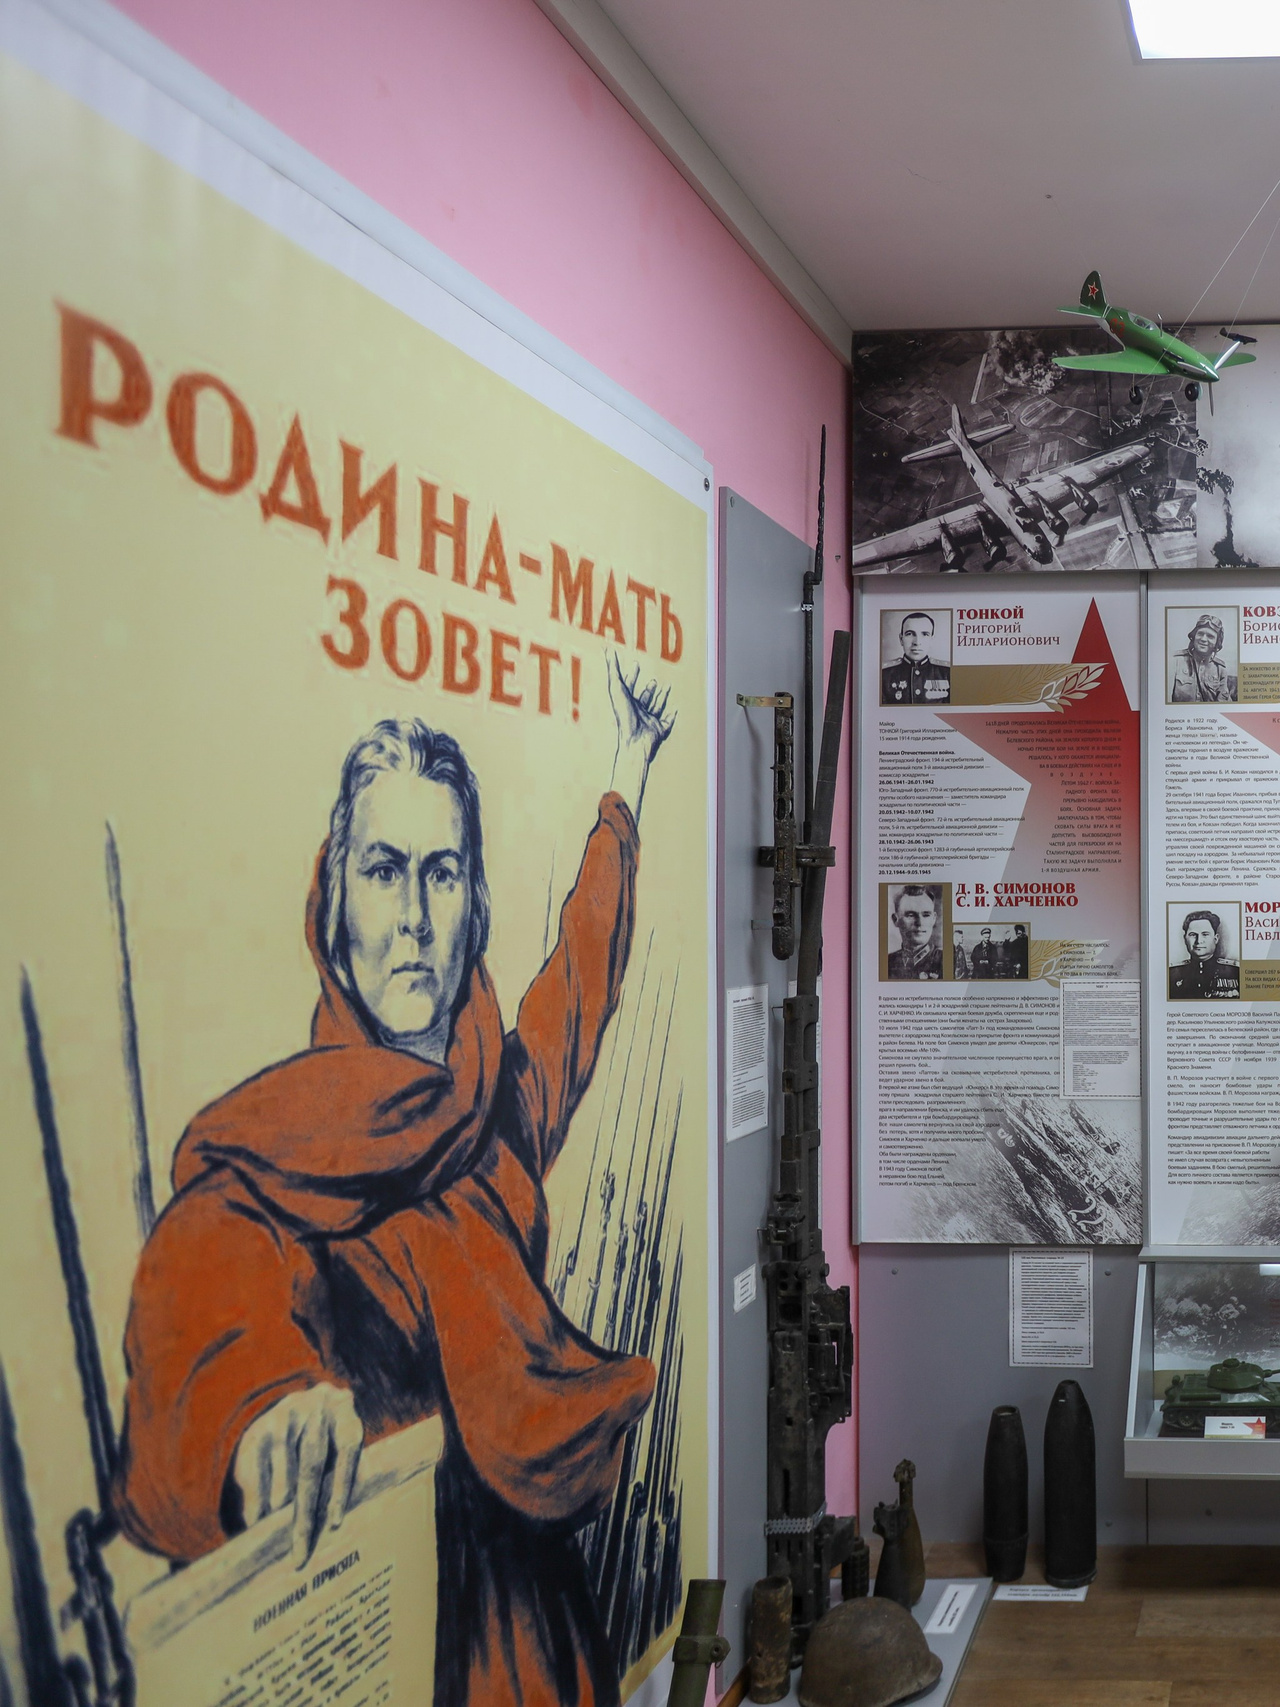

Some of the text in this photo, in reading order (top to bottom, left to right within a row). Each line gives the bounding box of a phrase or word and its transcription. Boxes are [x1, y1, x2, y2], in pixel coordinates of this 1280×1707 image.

[53, 295, 684, 666] РОДИНА-МАТЬ
[957, 607, 1024, 620] ТОНКОЙ
[321, 575, 582, 723] ЗОВЕТ!
[956, 882, 1076, 897] Д. В. СИМОНОВ
[956, 895, 1079, 908] С. И. ХАРЧЕНКО
